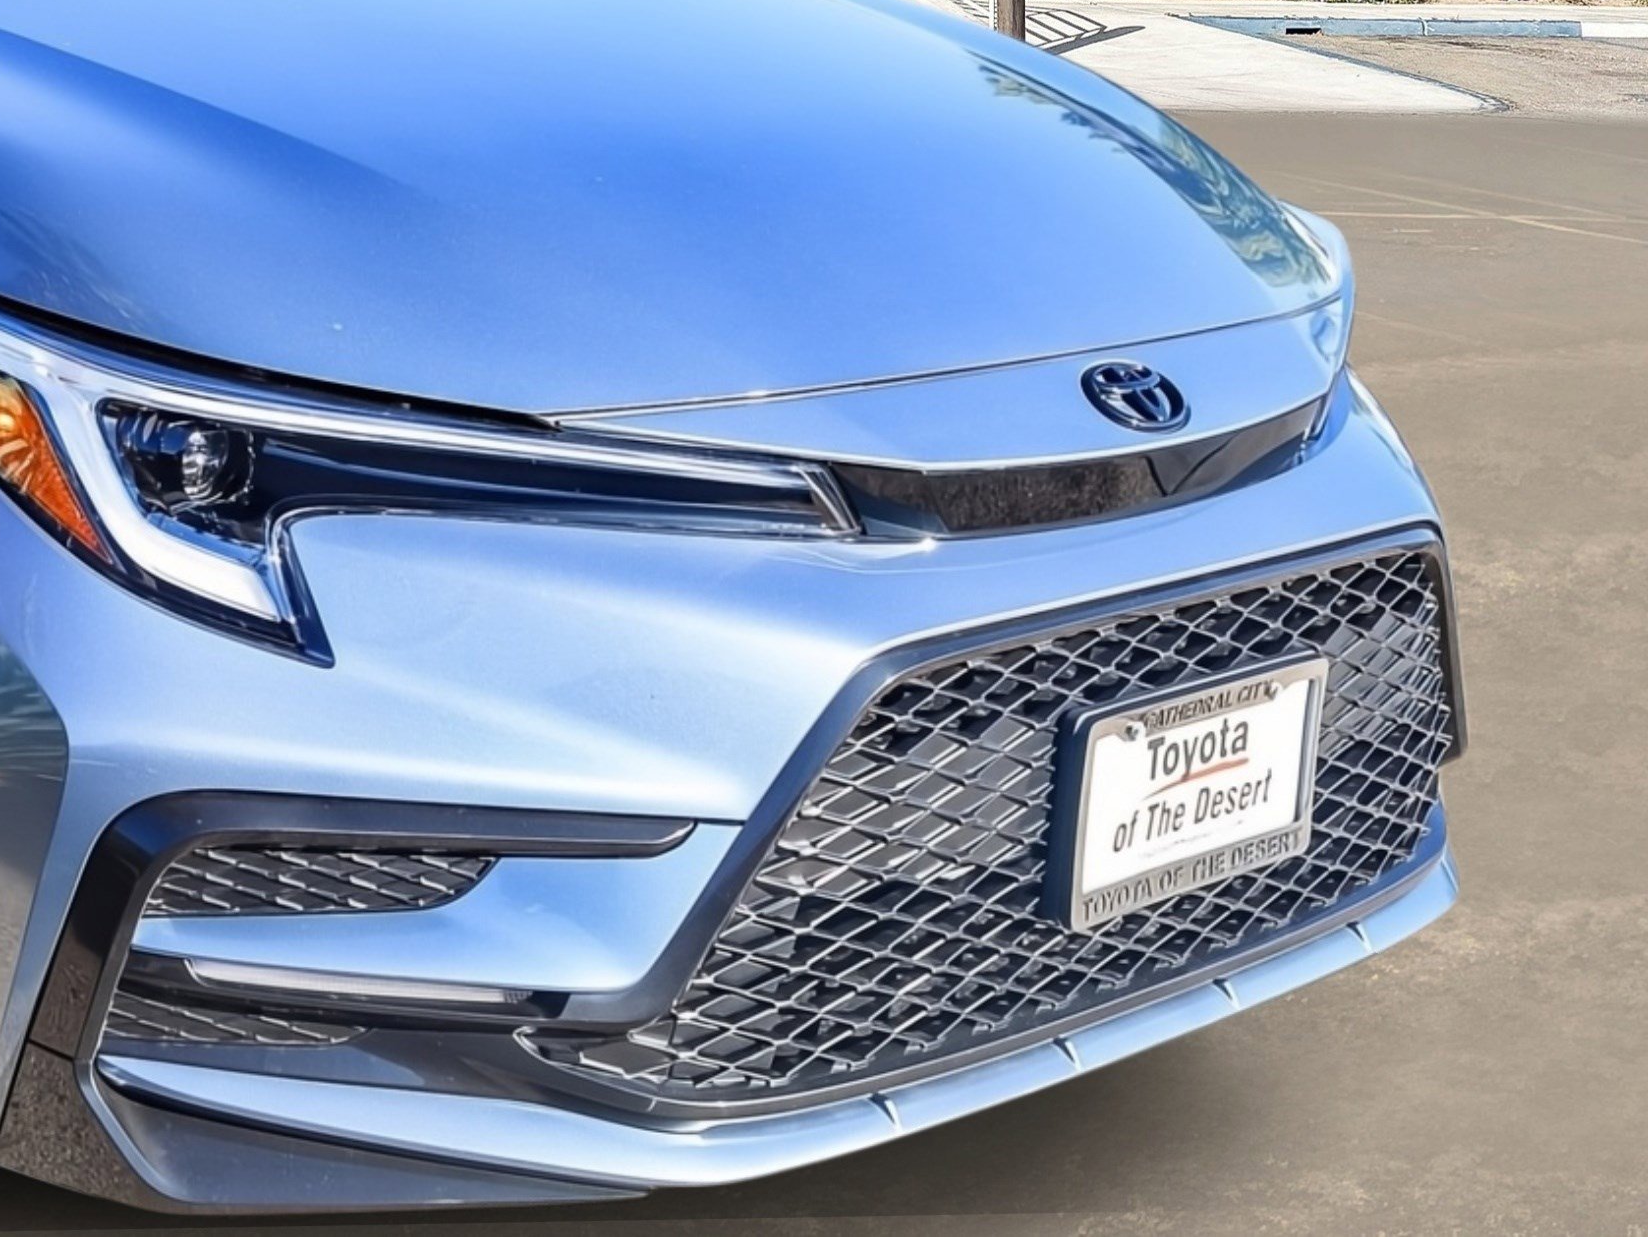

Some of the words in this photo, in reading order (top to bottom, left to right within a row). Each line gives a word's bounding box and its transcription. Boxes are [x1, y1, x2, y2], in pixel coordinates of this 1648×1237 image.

[1147, 717, 1249, 783] Toyota
[1113, 809, 1140, 853] of
[1146, 797, 1186, 842] The
[1194, 767, 1273, 825] Desert
[1082, 878, 1153, 922] TOYOTA
[1158, 865, 1186, 892] OF
[1190, 851, 1227, 883] THE
[1230, 829, 1303, 869] DESERT
